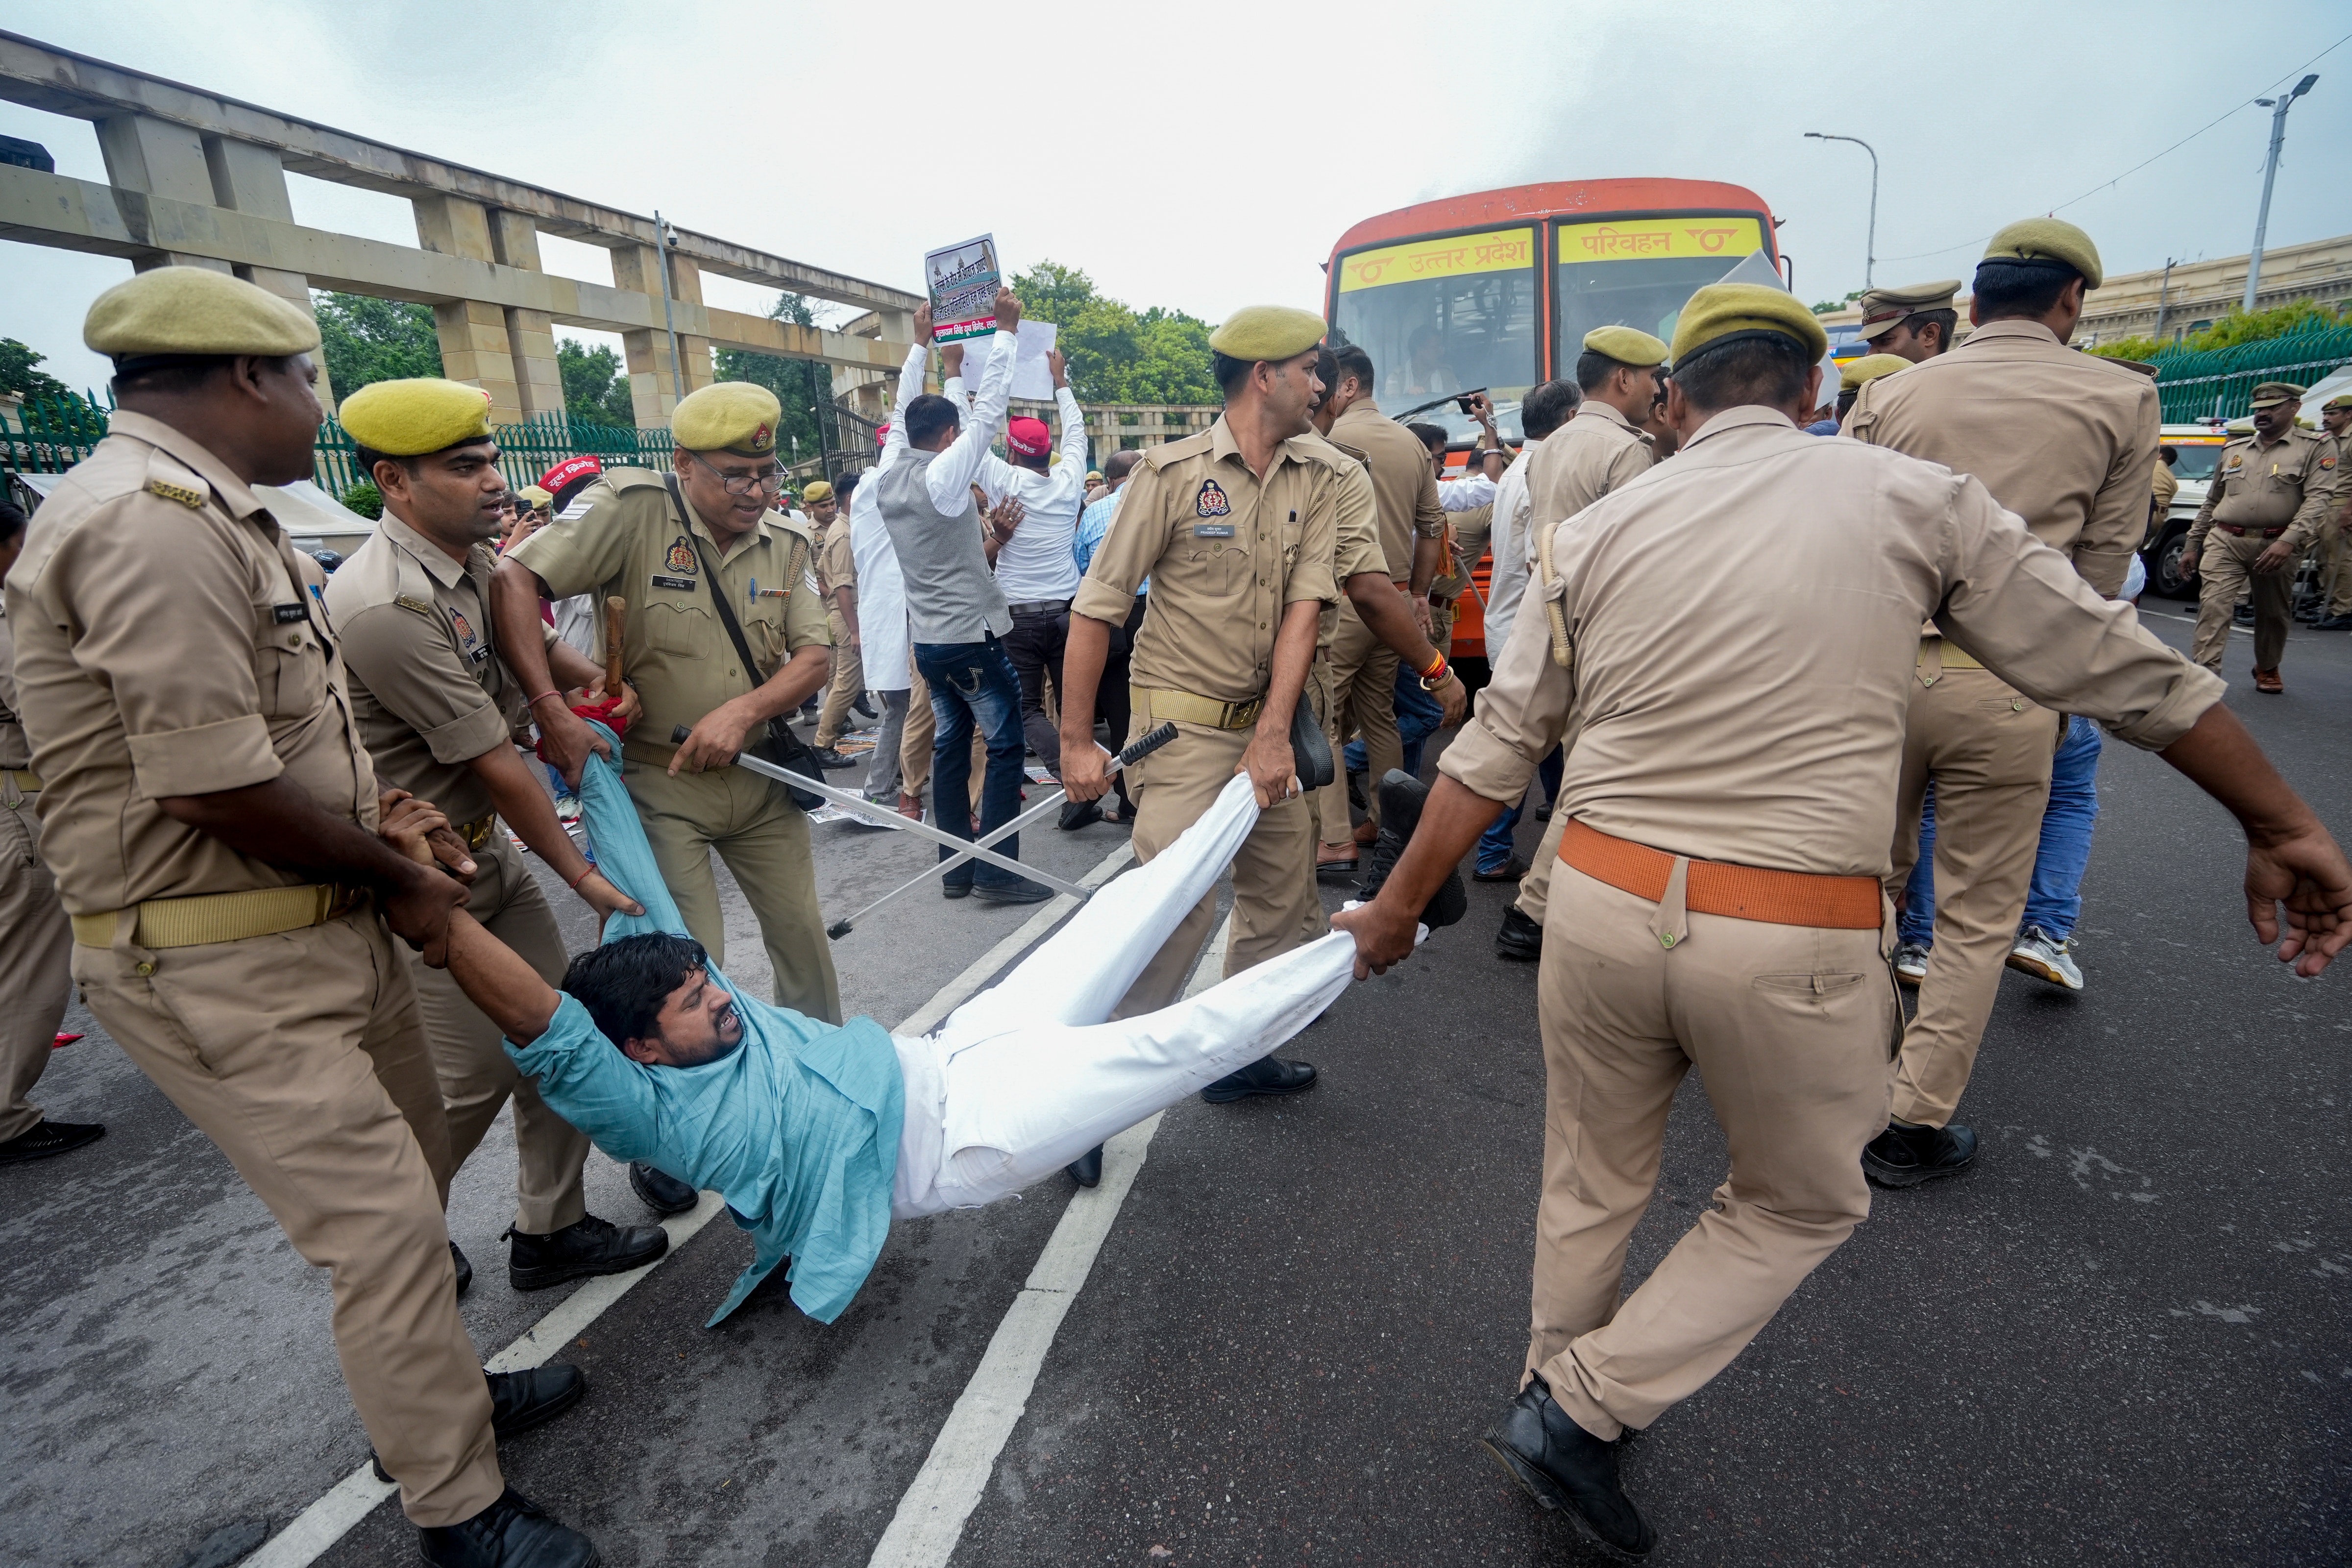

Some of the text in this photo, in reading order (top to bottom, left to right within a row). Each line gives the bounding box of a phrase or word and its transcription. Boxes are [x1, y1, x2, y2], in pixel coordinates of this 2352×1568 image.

[1581, 227, 1672, 255] परिवहन
[1408, 236, 1527, 273] उत्तर प्रदेश
[944, 274, 950, 289] के
[949, 271, 958, 287] दौर
[970, 291, 978, 304] हम
[935, 327, 953, 341] मुलायम
[954, 324, 963, 335] सिंह
[1010, 436, 1036, 453] ब्रिगेड
[548, 460, 595, 487] यूथ ब्रिगेड
